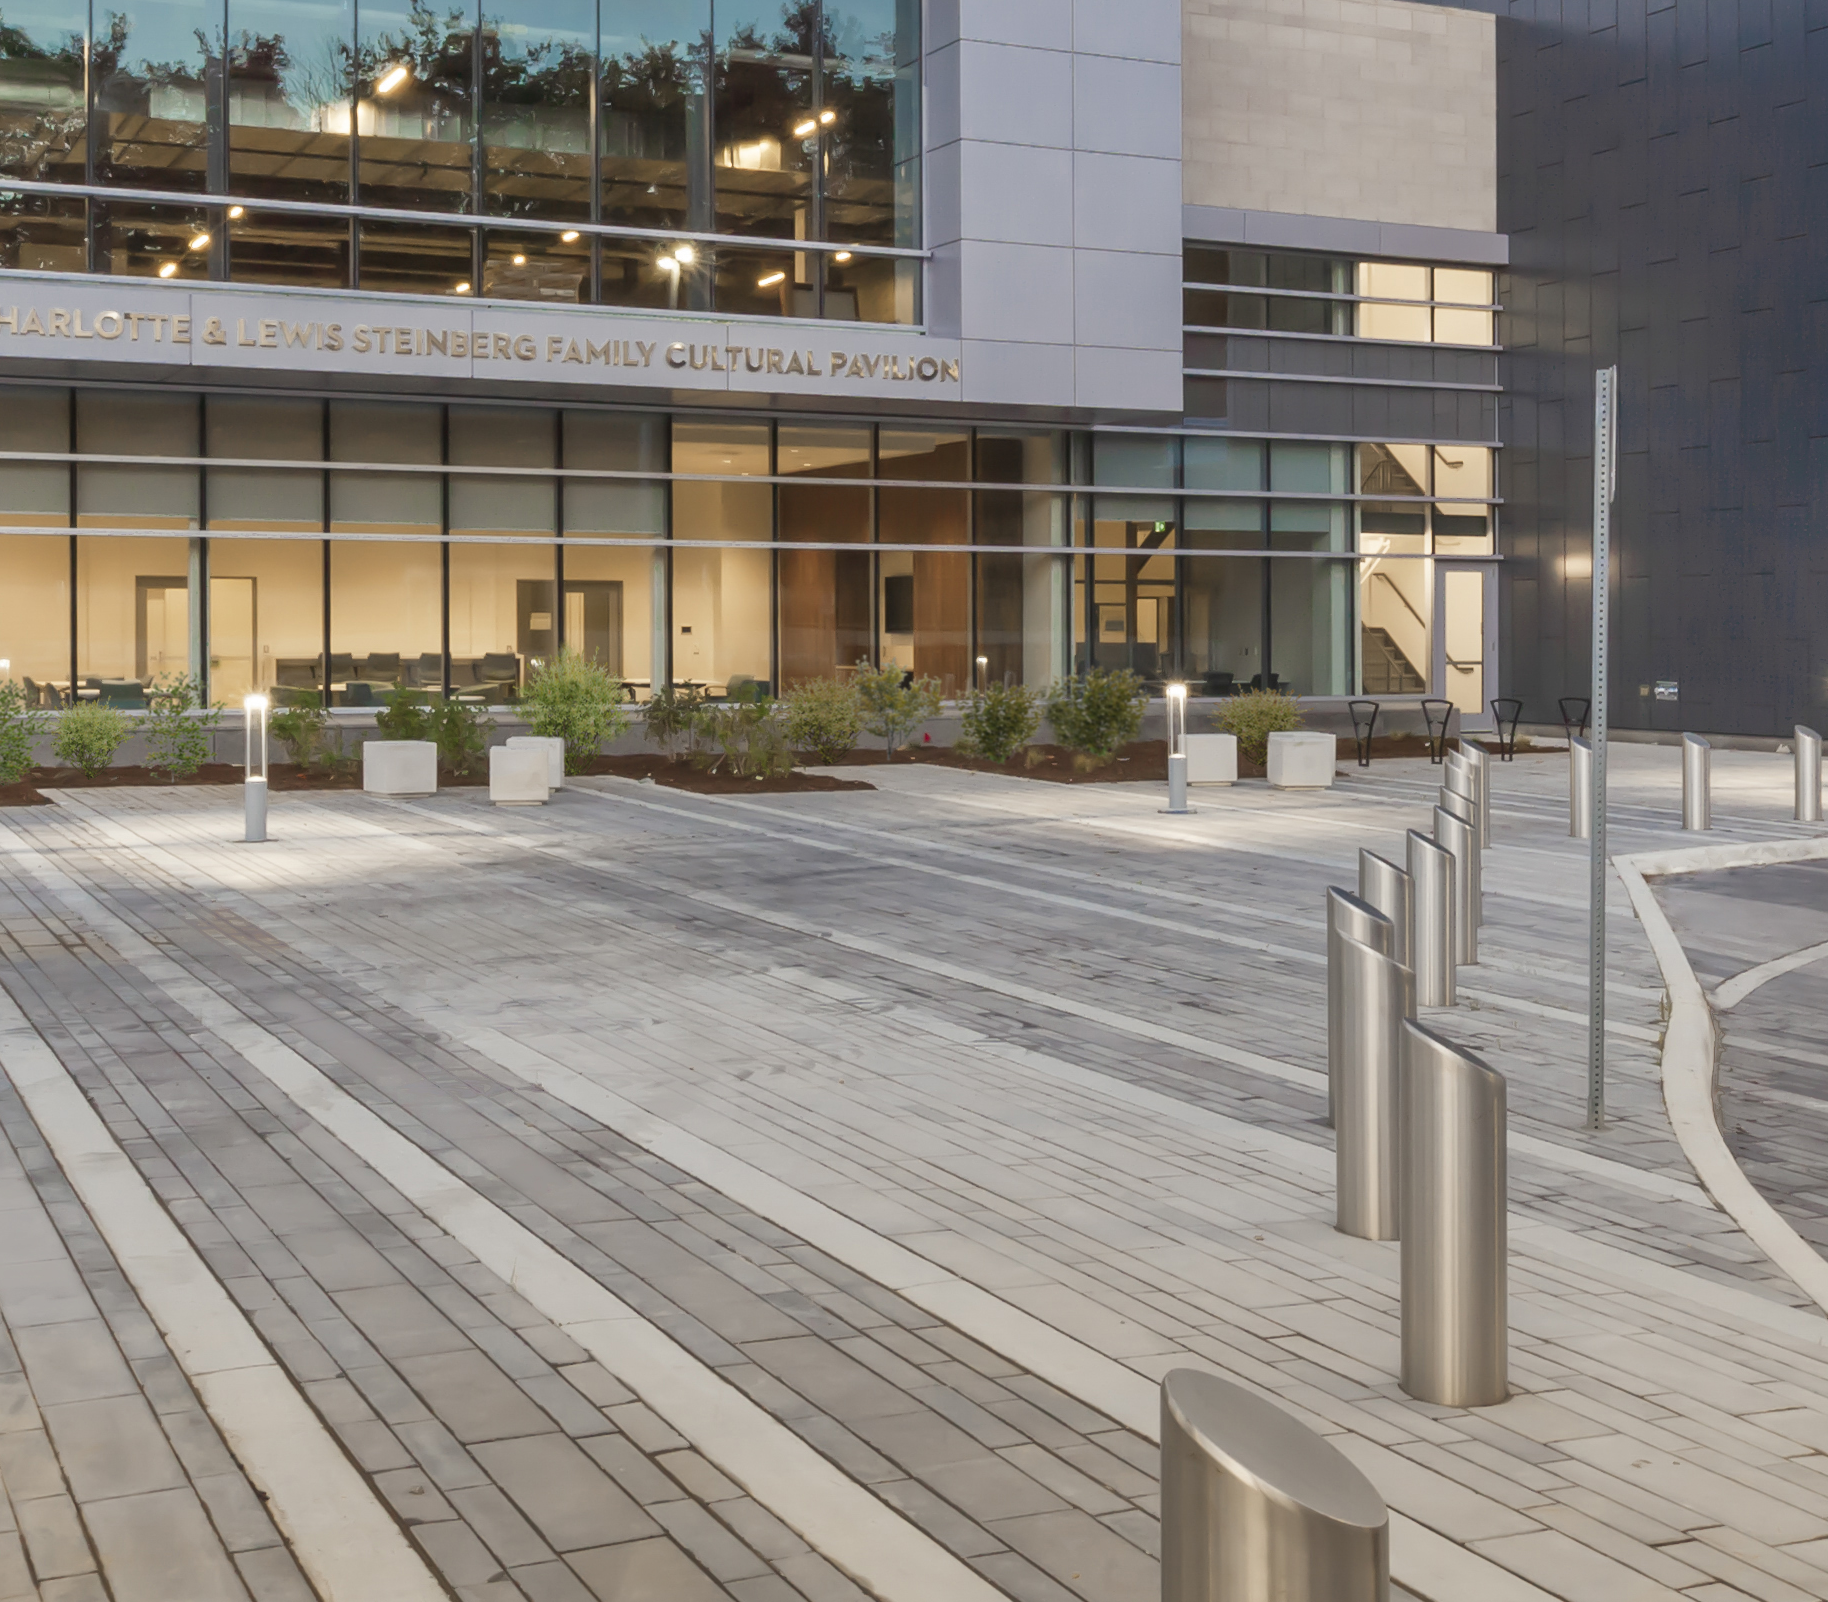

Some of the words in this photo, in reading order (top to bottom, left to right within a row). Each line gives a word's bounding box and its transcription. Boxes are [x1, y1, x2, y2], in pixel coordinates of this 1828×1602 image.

[202, 316, 226, 345] &
[237, 318, 343, 352] LEWIS
[352, 324, 536, 361] STEINBERG
[546, 336, 656, 367] FAMILY
[665, 342, 823, 376] CULTURAL
[831, 351, 960, 382] PAVILION
